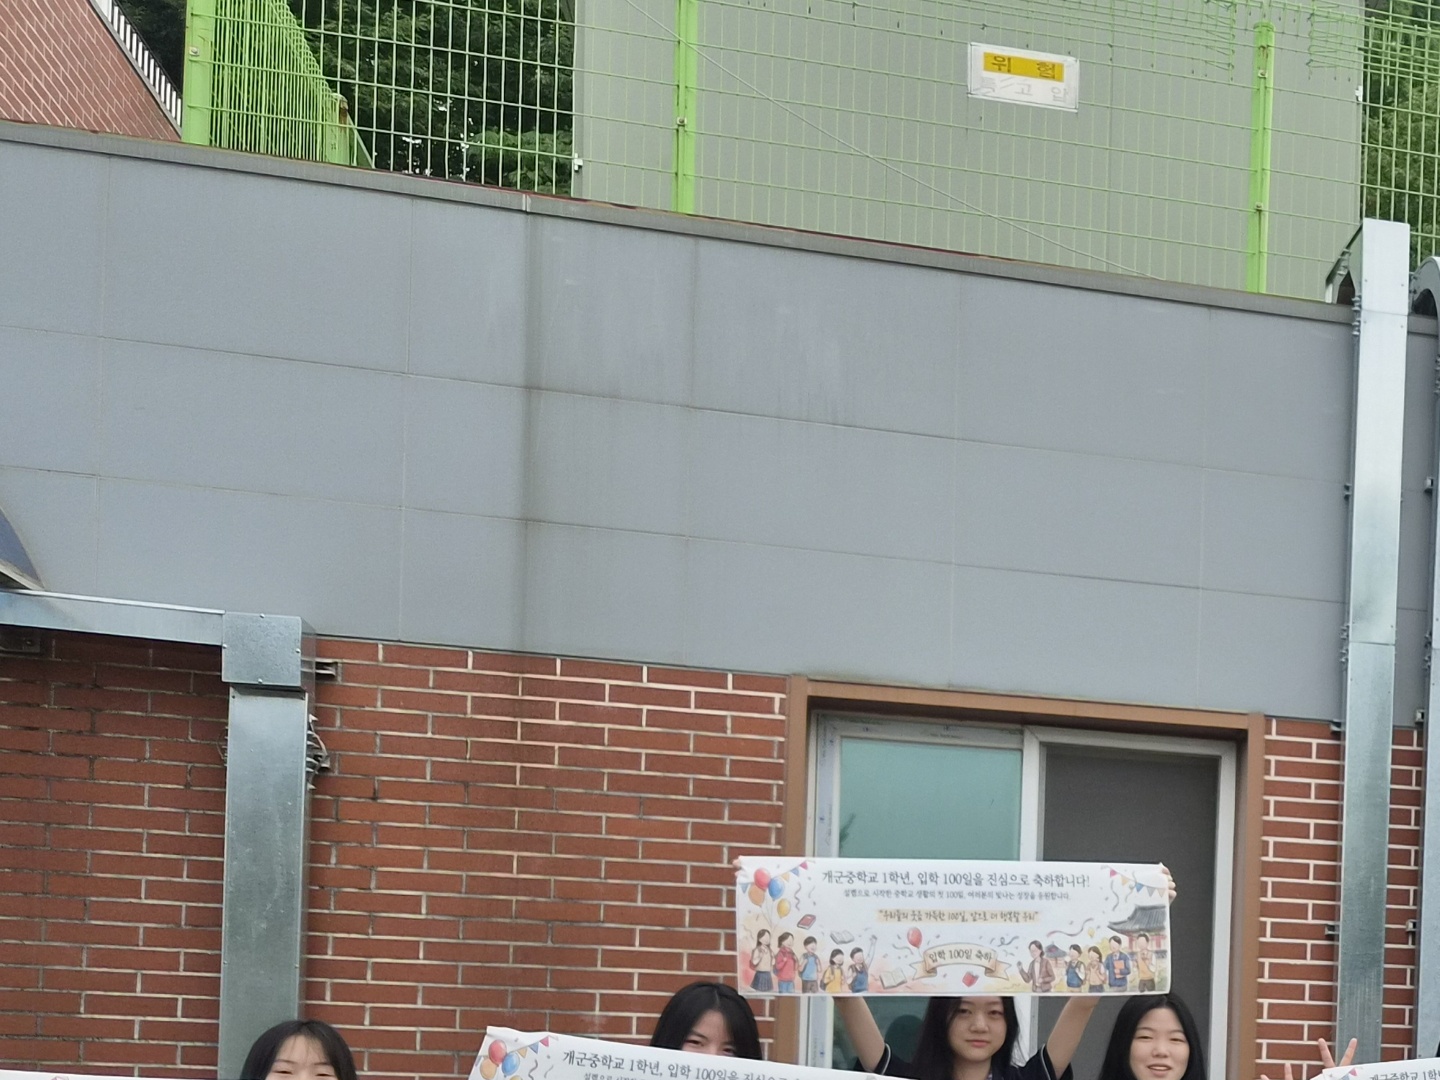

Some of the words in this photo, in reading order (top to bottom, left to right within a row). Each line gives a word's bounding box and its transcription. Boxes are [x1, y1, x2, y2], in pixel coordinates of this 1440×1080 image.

[822, 870, 878, 884] 개군중학교
[883, 871, 914, 885] 1학년,
[917, 871, 939, 885] 입학
[943, 872, 983, 886] 100일을
[987, 872, 1029, 886] 진심으로
[1032, 873, 1089, 887] 축하합니다!
[928, 950, 946, 962] 입학
[949, 949, 972, 960] 100일
[976, 950, 992, 962] 축하
[562, 1050, 624, 1069] 개군중학교
[629, 1059, 662, 1076] 1학년,
[667, 1063, 691, 1079] 입학
